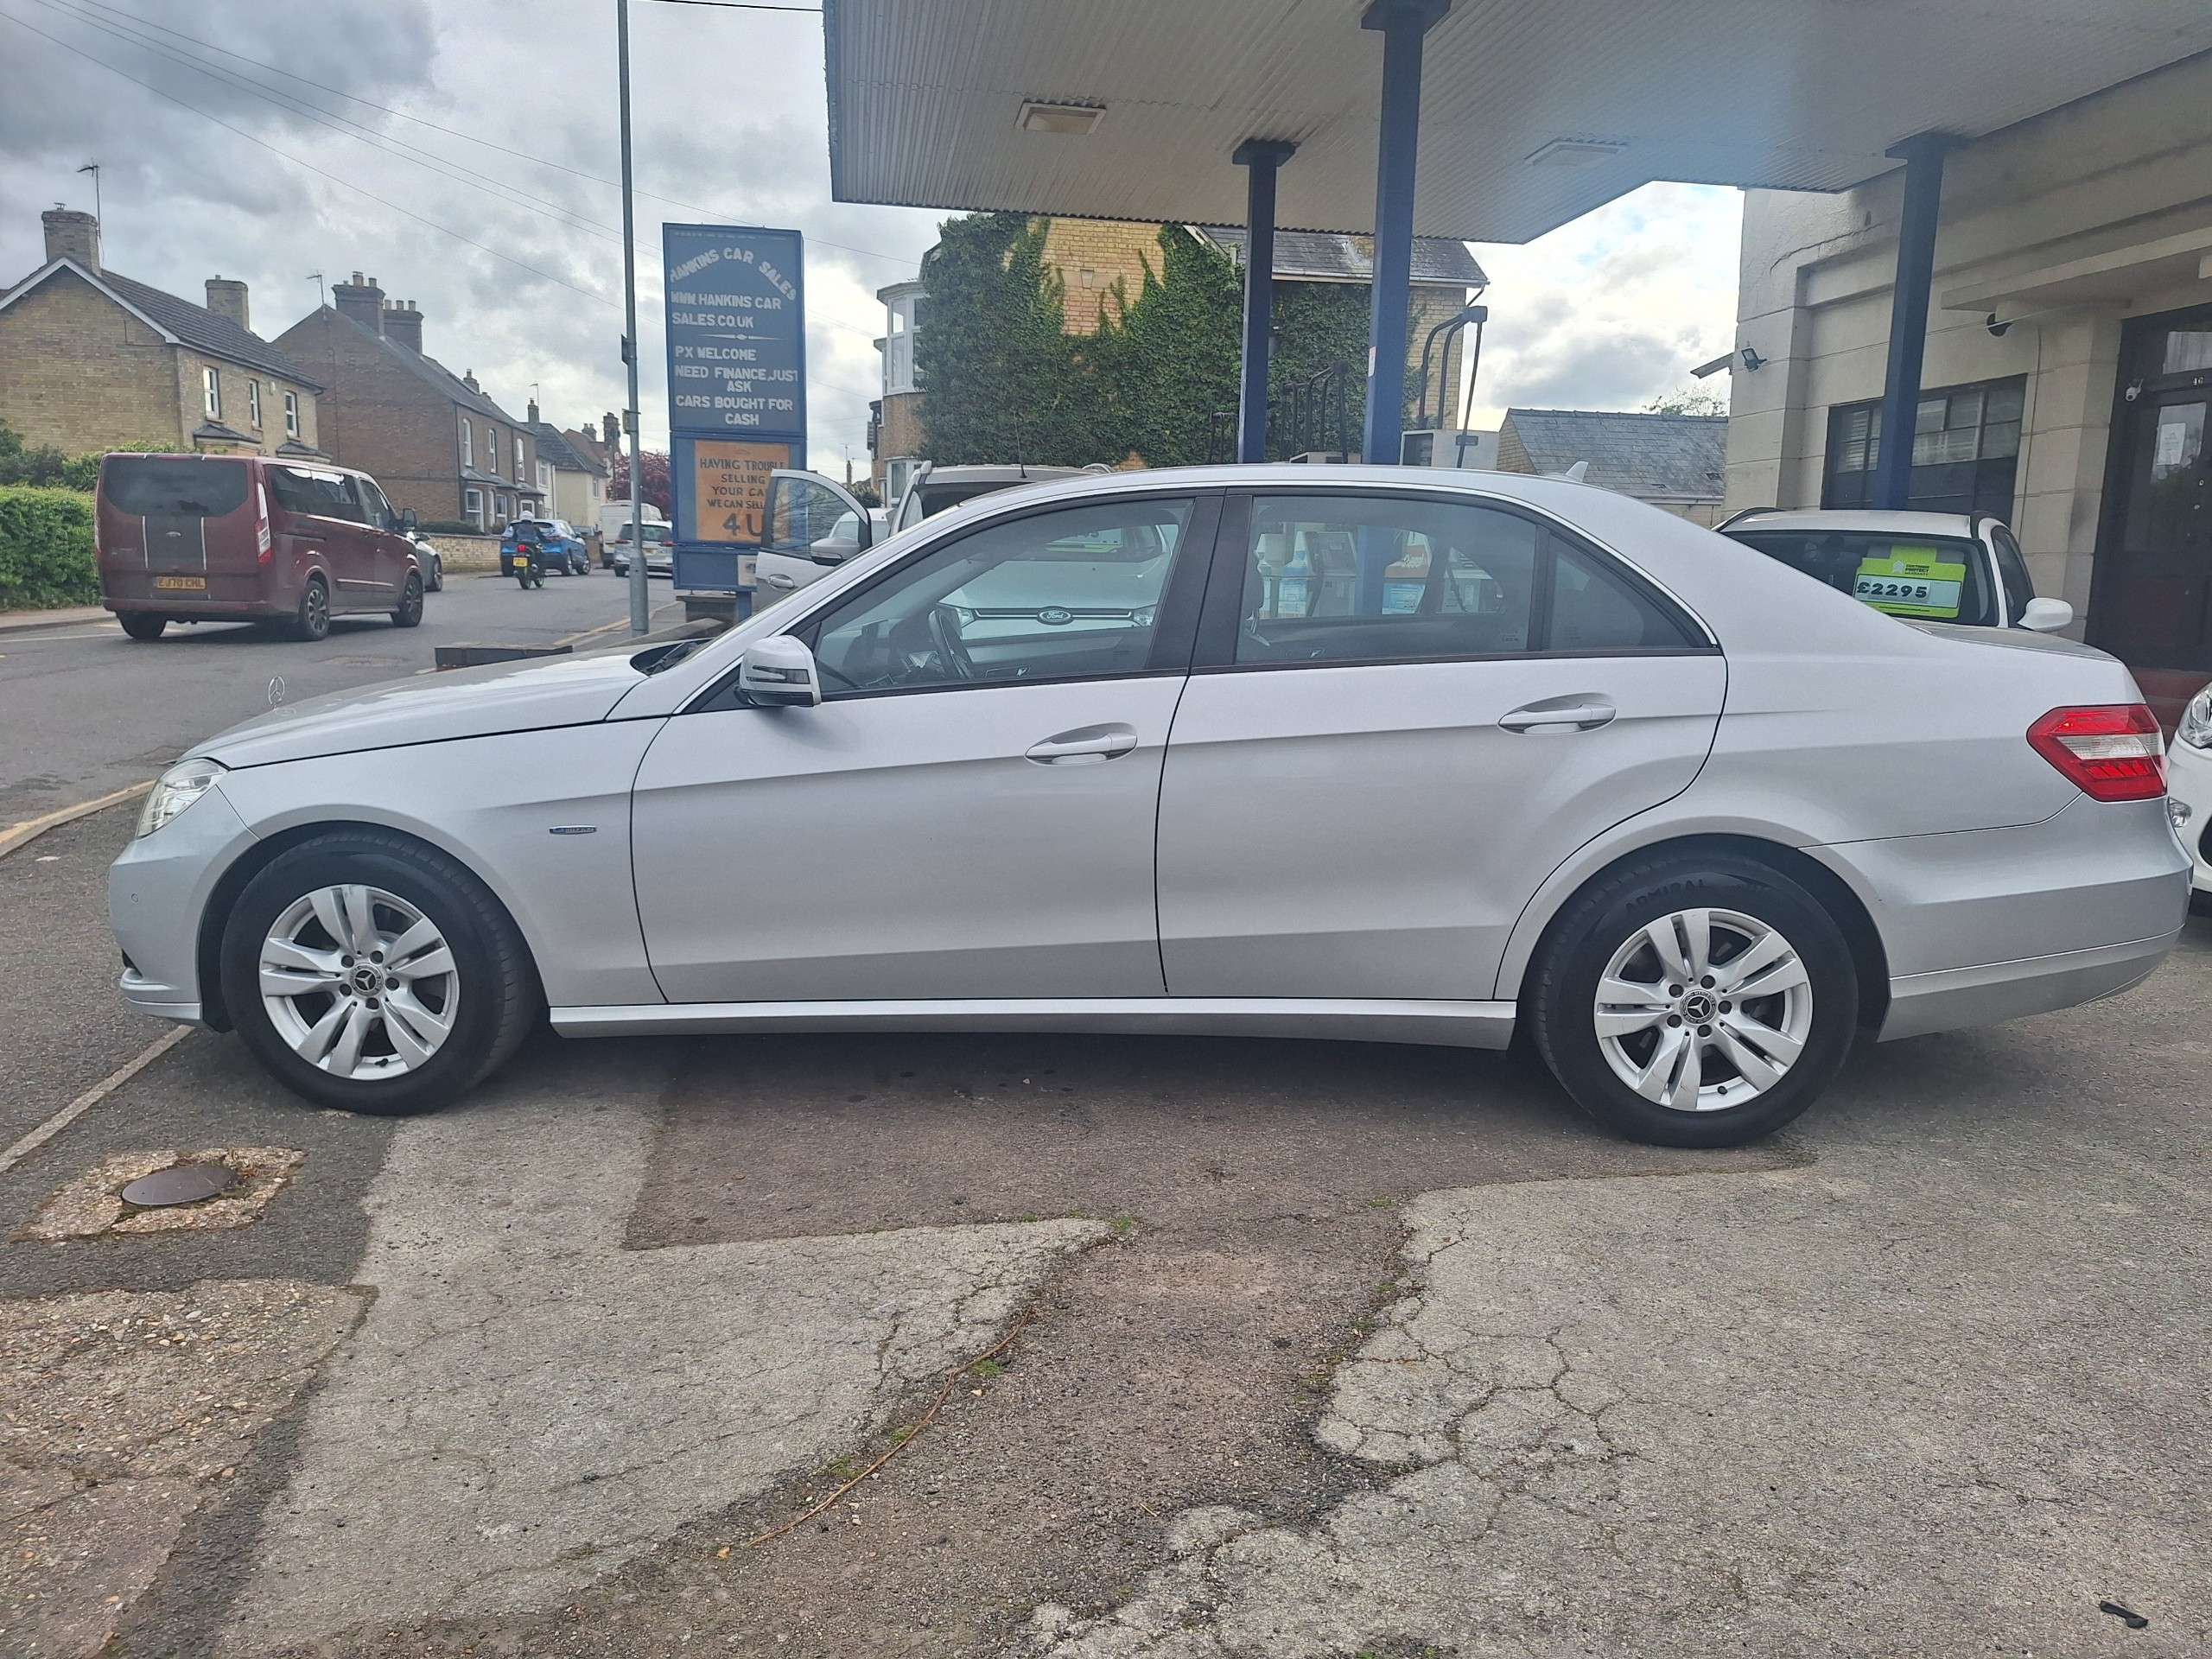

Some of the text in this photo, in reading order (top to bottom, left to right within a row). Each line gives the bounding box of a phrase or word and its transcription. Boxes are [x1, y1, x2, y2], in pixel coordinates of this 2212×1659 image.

[670, 246, 797, 301] HANKINS CAR SALES
[754, 296, 782, 309] CAR
[675, 345, 757, 361] PX WELCOME
[674, 364, 709, 378] NEED
[726, 380, 753, 393] ASK
[675, 394, 793, 410] CARS BOUGHT FOR
[724, 412, 760, 426] CASH
[699, 457, 741, 470] HAVING
[720, 474, 766, 485] SELLING
[711, 486, 767, 497] YOUR CA
[707, 498, 721, 508] WE
[724, 499, 744, 508] CAN
[721, 512, 741, 537] 4
[1857, 582, 1928, 598] £2295
[1046, 610, 1065, 619] Ford
